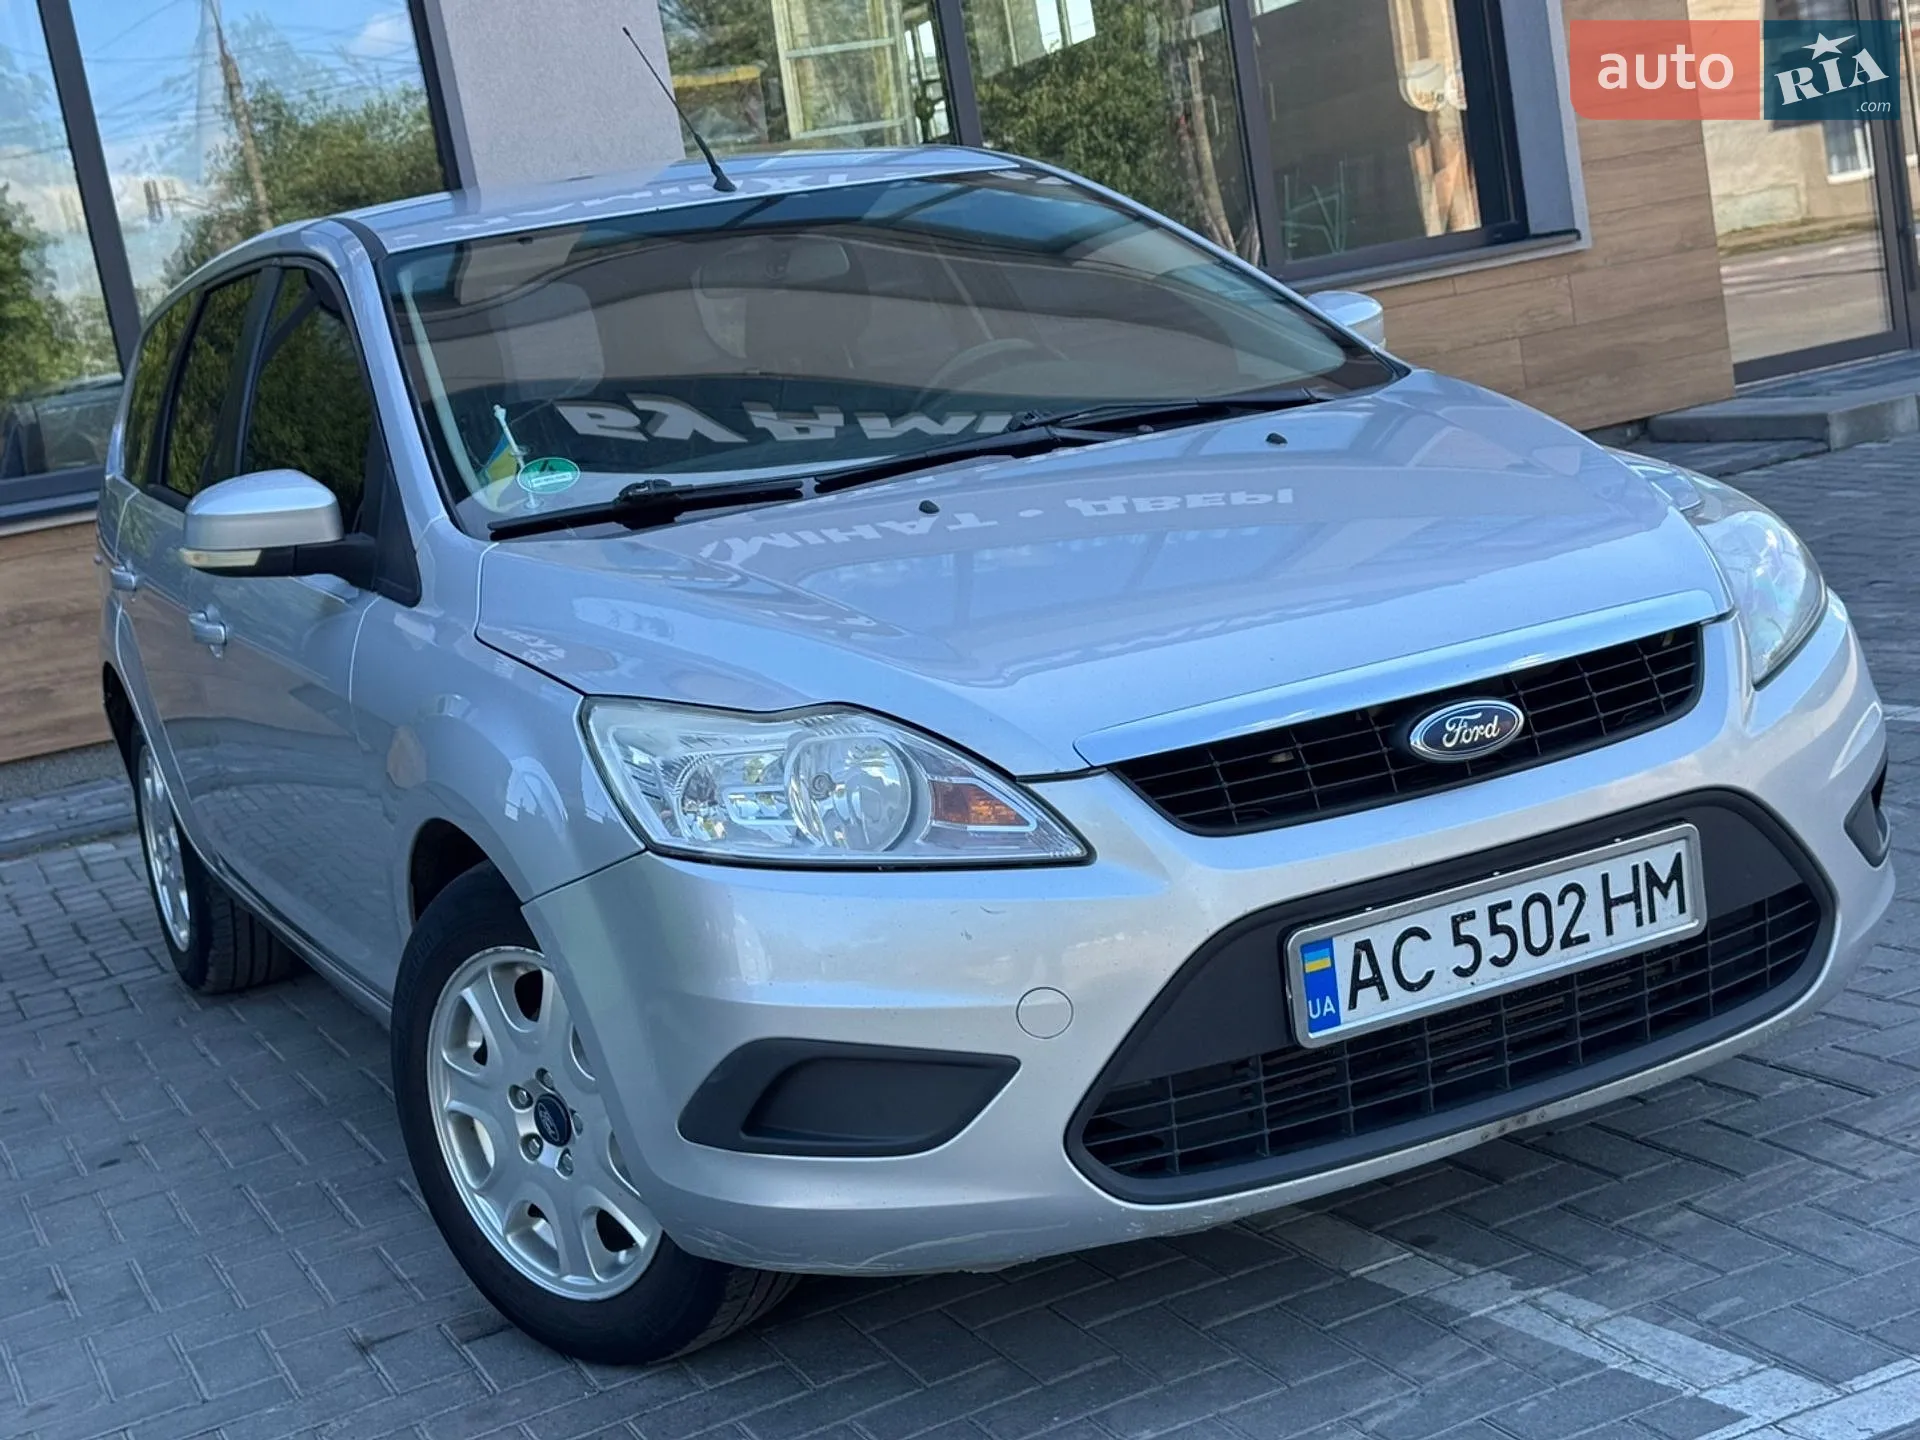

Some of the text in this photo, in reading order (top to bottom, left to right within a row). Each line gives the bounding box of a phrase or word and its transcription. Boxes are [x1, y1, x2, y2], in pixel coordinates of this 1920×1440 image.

[1442, 711, 1501, 748] Ford
[1347, 851, 1688, 1011] AC 5502 HM
[1308, 995, 1336, 1020] UA
